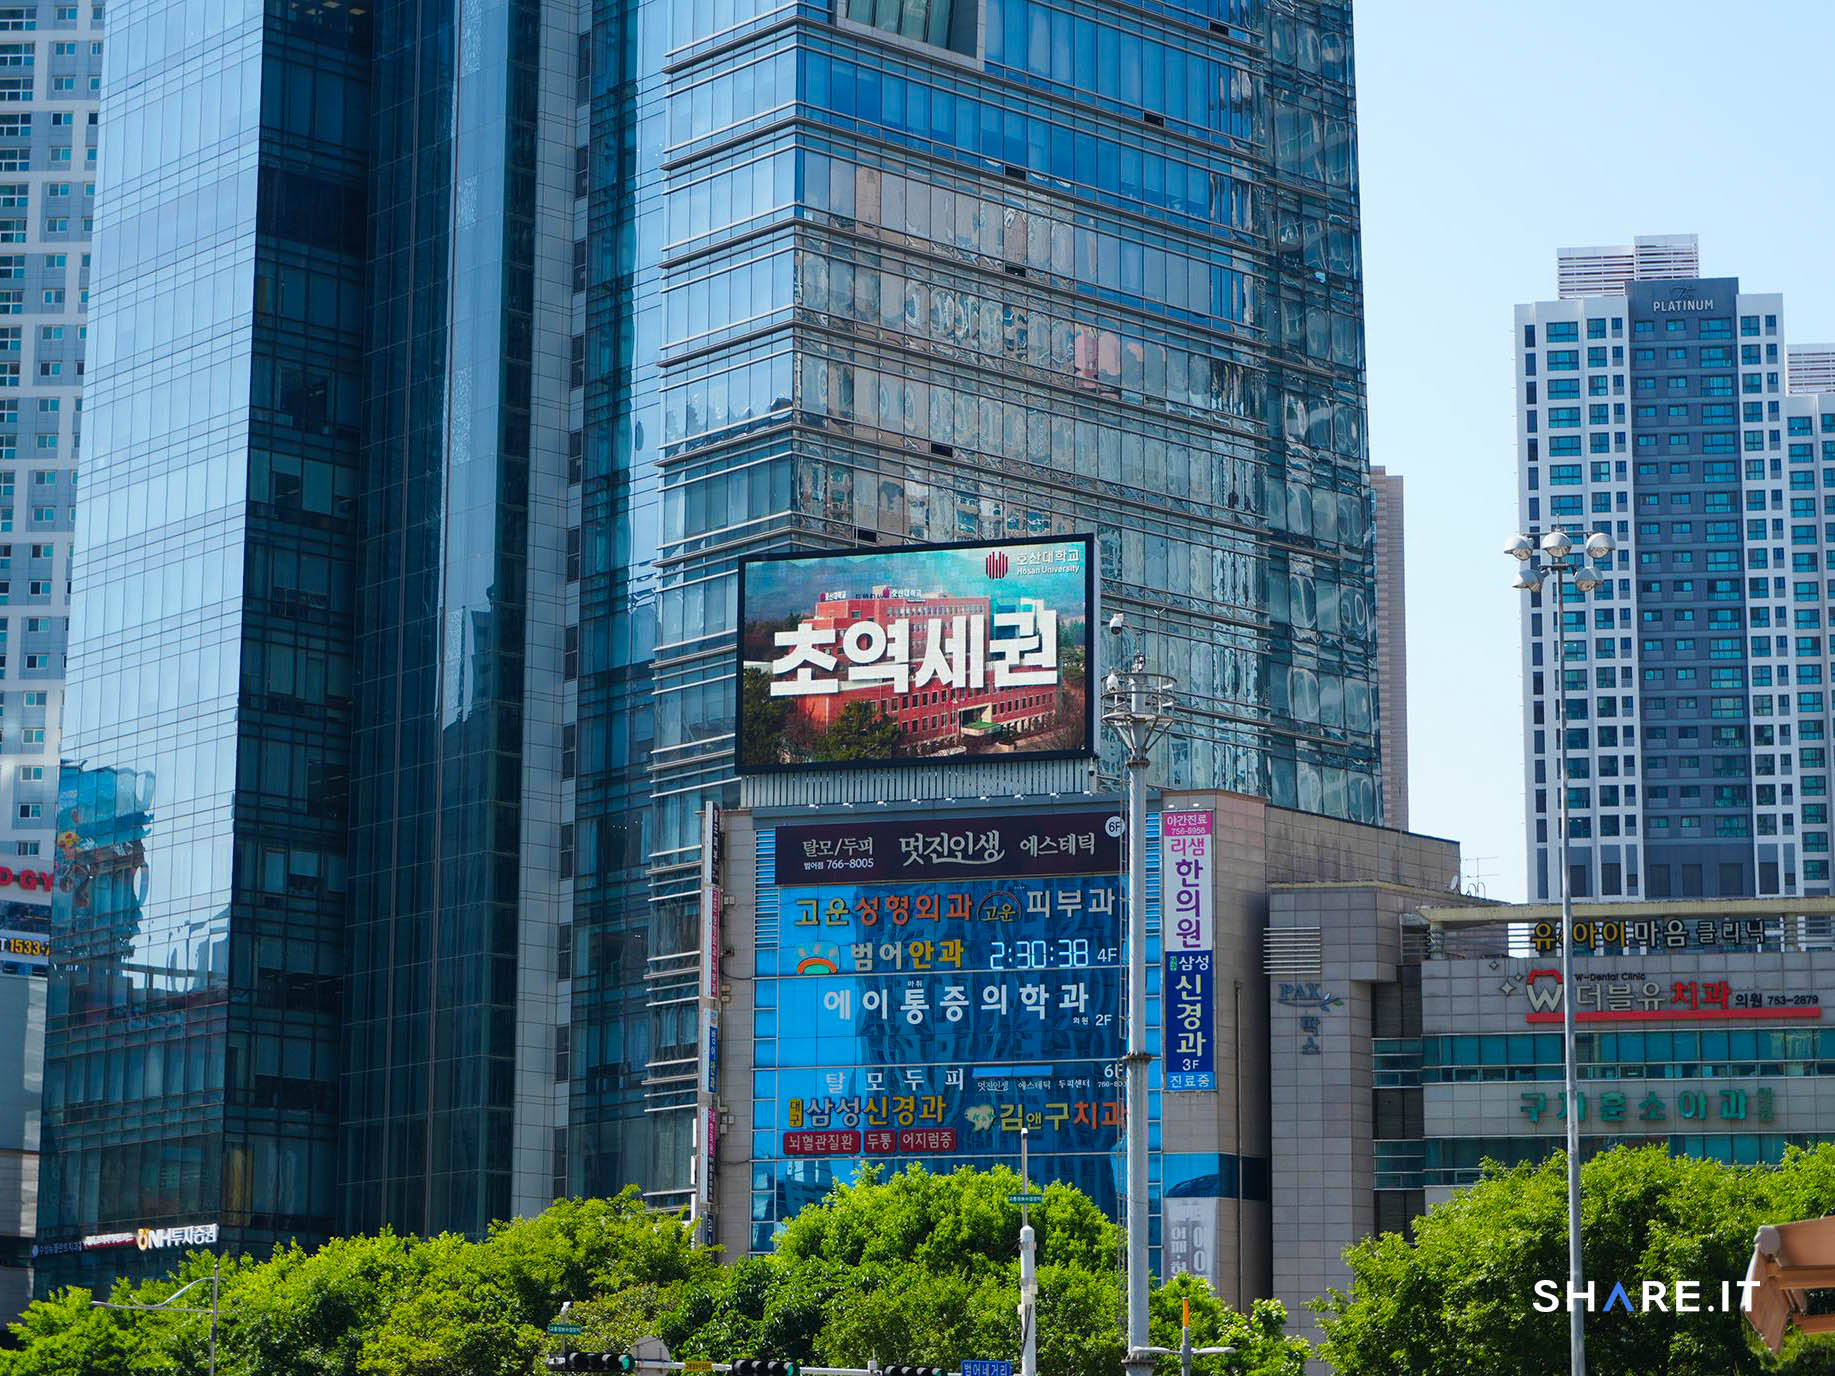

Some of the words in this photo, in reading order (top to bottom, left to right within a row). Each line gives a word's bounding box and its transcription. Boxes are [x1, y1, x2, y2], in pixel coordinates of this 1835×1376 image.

[1653, 299, 1714, 312] PLATINUM
[1017, 549, 1080, 566] 호산대학교
[1017, 566, 1041, 576] Hosan
[1041, 564, 1080, 574] University
[770, 609, 1058, 697] 초역세권
[1167, 814, 1208, 827] 야간진료
[802, 836, 874, 858] 탈모/두피
[898, 830, 1006, 867] 멋진인생
[1019, 832, 1096, 858] 에스테틱
[1171, 838, 1205, 857] 리샘
[826, 857, 874, 871] 766-8005
[1027, 888, 1116, 918] 피부과
[1176, 858, 1204, 948] 한의원
[1532, 919, 1688, 950] 유아이마음
[1696, 920, 1765, 945] 클리닉
[851, 939, 965, 972] 범어안과
[990, 939, 1089, 969] 2:30:38
[1097, 947, 1118, 963] 4F
[1178, 955, 1209, 971] 삼성
[1620, 971, 1647, 981] Clinic
[1736, 992, 1763, 1009] 의원
[1767, 994, 1820, 1007] 753-2879
[1095, 1014, 1112, 1027] 2F
[1174, 974, 1207, 1057] 신경과
[1182, 1058, 1200, 1072] 3F
[1058, 1079, 1091, 1089] 두피센터
[1170, 1074, 1210, 1090] 진료중
[806, 1096, 947, 1127] 삼성신경과
[788, 1133, 853, 1151] 뇌혈관질환
[867, 1133, 893, 1150] 두통
[902, 1131, 953, 1149] 어지럼증
[148, 1223, 218, 1249] NH투자증권
